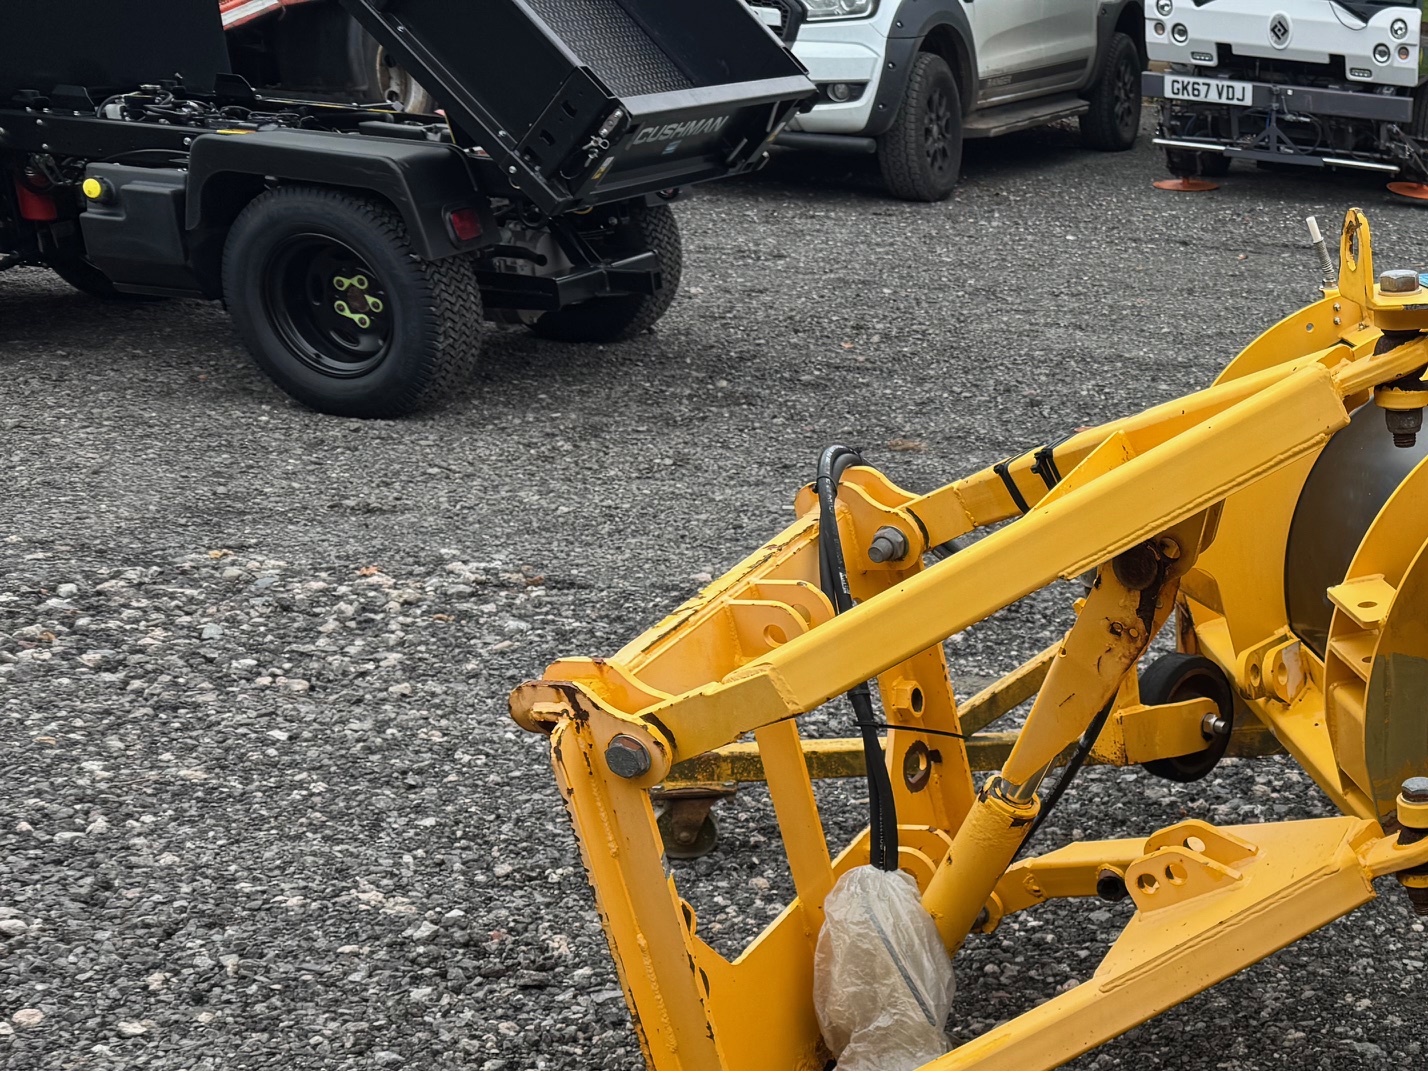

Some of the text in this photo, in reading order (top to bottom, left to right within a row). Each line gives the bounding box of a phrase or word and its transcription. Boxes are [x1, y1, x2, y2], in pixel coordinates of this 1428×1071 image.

[1171, 80, 1245, 102] GK67 VDJ
[632, 115, 729, 145] CUSHMAN
